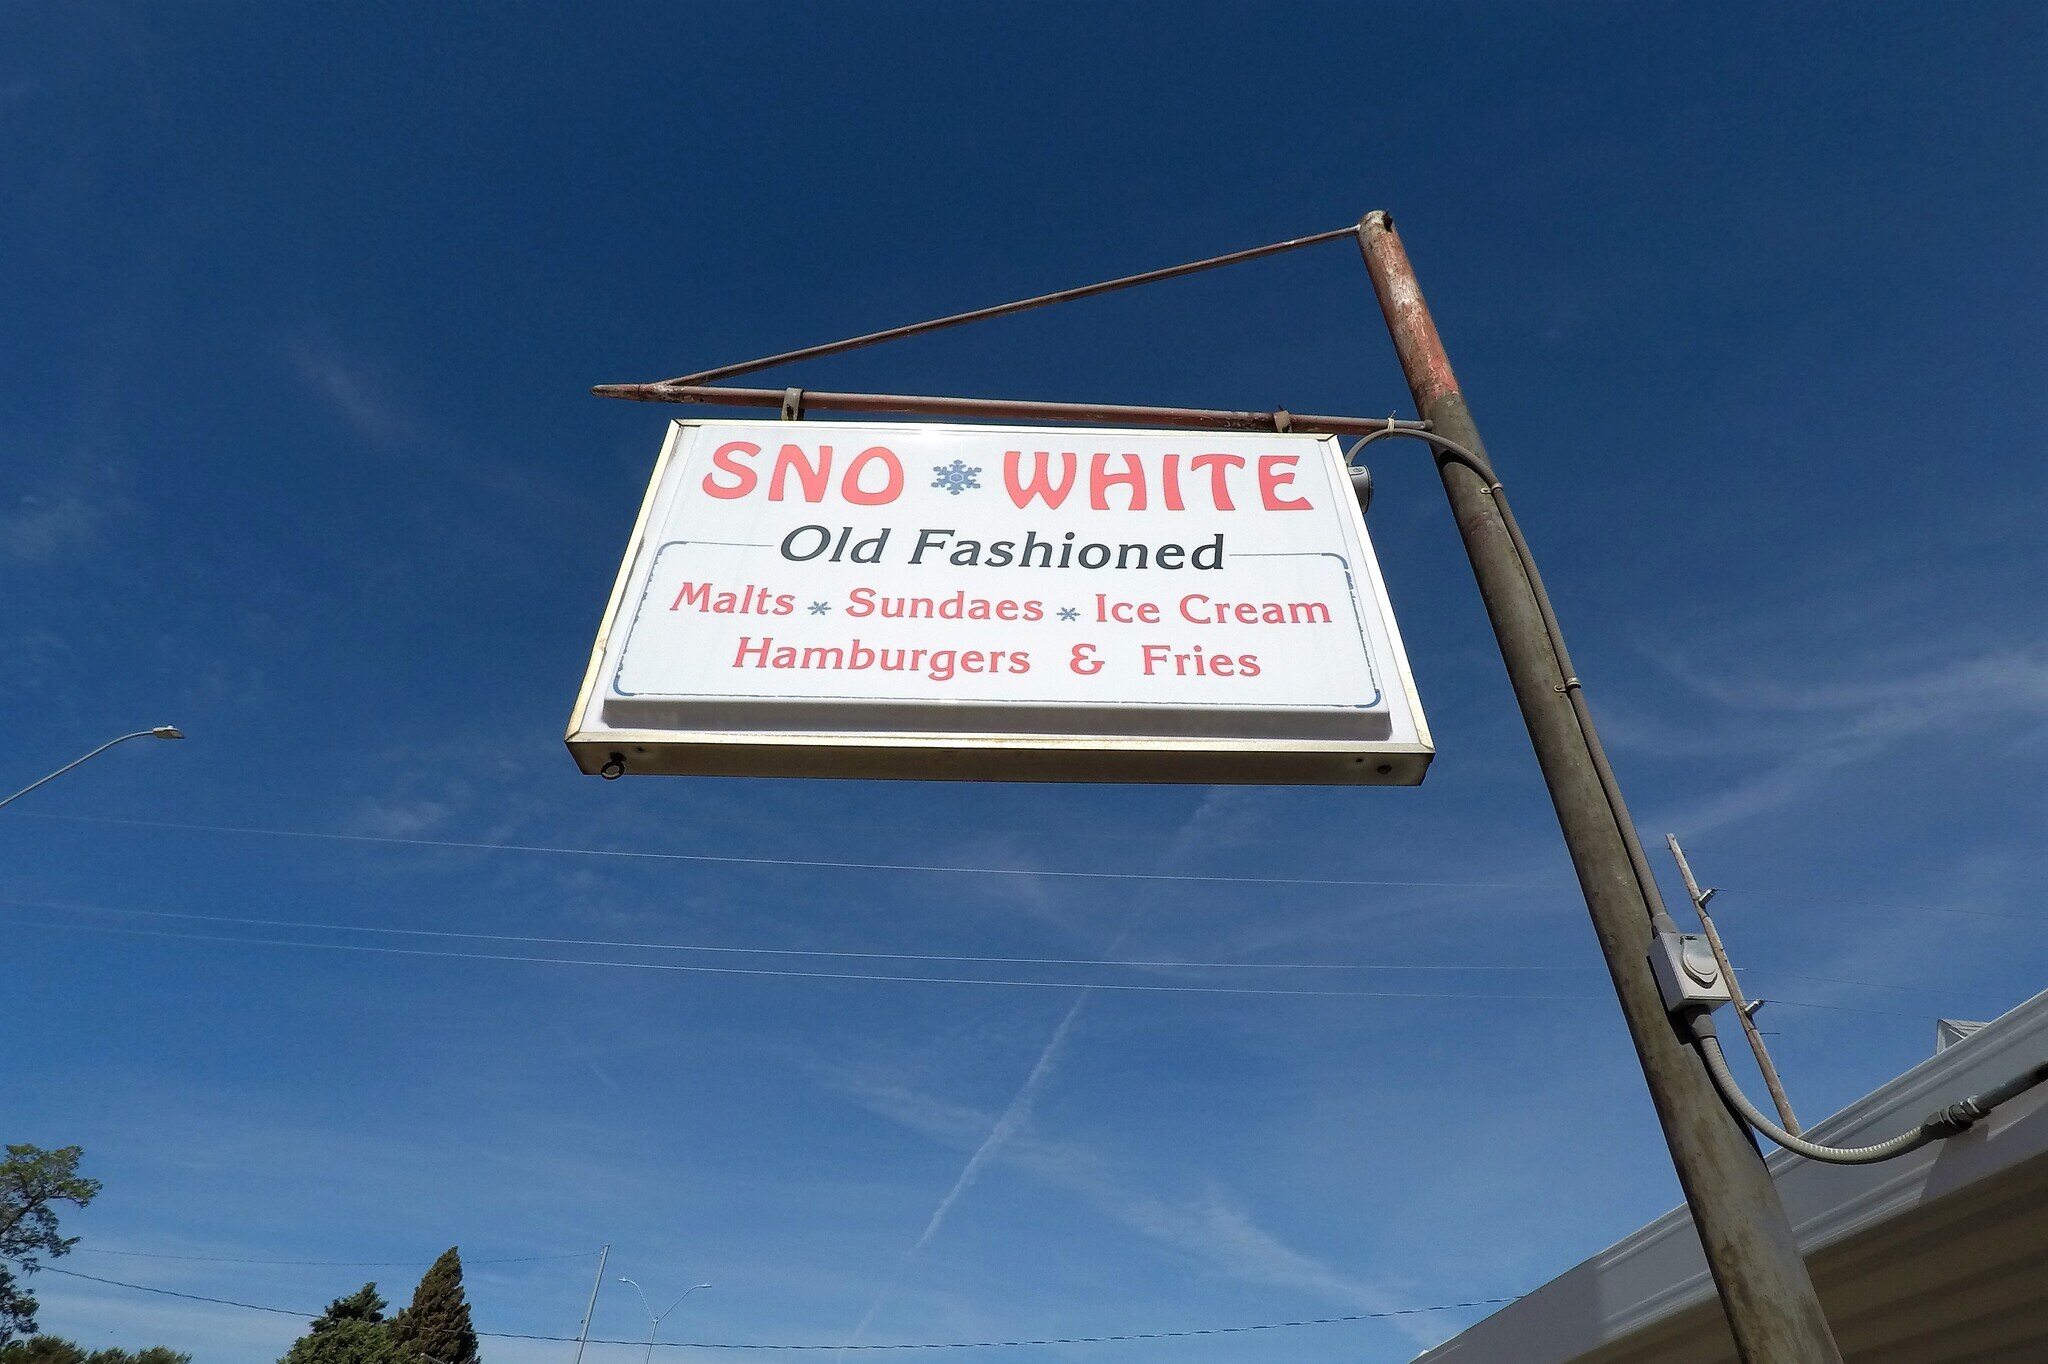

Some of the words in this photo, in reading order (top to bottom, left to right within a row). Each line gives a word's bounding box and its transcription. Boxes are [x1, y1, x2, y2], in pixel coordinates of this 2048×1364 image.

[701, 440, 904, 506] SNO
[1003, 450, 1313, 512] WHITE
[780, 524, 890, 564] Old
[907, 528, 1224, 571] Fashioned
[671, 581, 794, 616] Malts
[846, 587, 1044, 622] Sundaes
[1096, 593, 1159, 624] Ice
[1179, 593, 1331, 625] Cream
[733, 636, 1030, 682] Hamburgers
[1069, 642, 1104, 675] &
[1142, 644, 1261, 677] Fries
